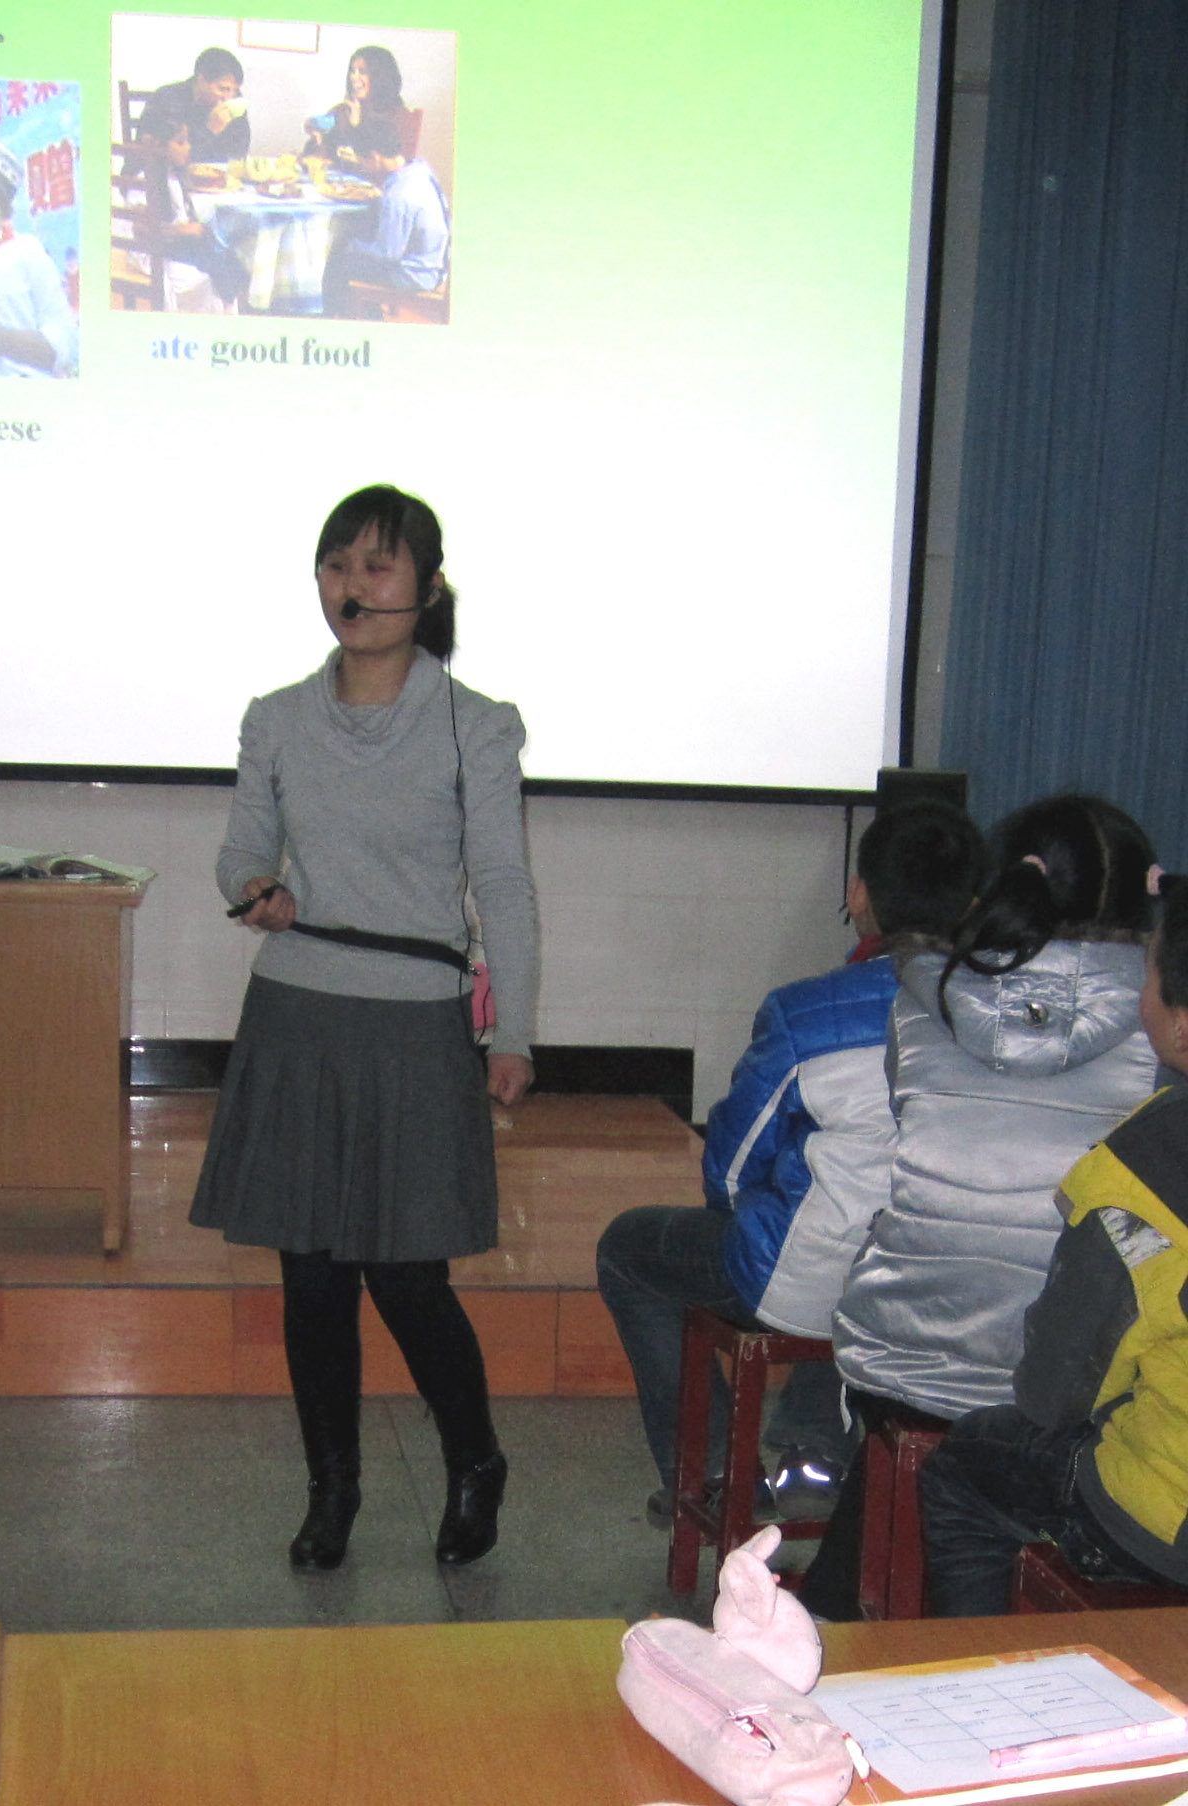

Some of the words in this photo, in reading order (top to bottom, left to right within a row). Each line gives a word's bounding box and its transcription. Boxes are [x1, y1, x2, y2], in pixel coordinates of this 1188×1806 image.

[151, 335, 200, 361] ate
[210, 336, 289, 369] good
[301, 337, 372, 368] food
